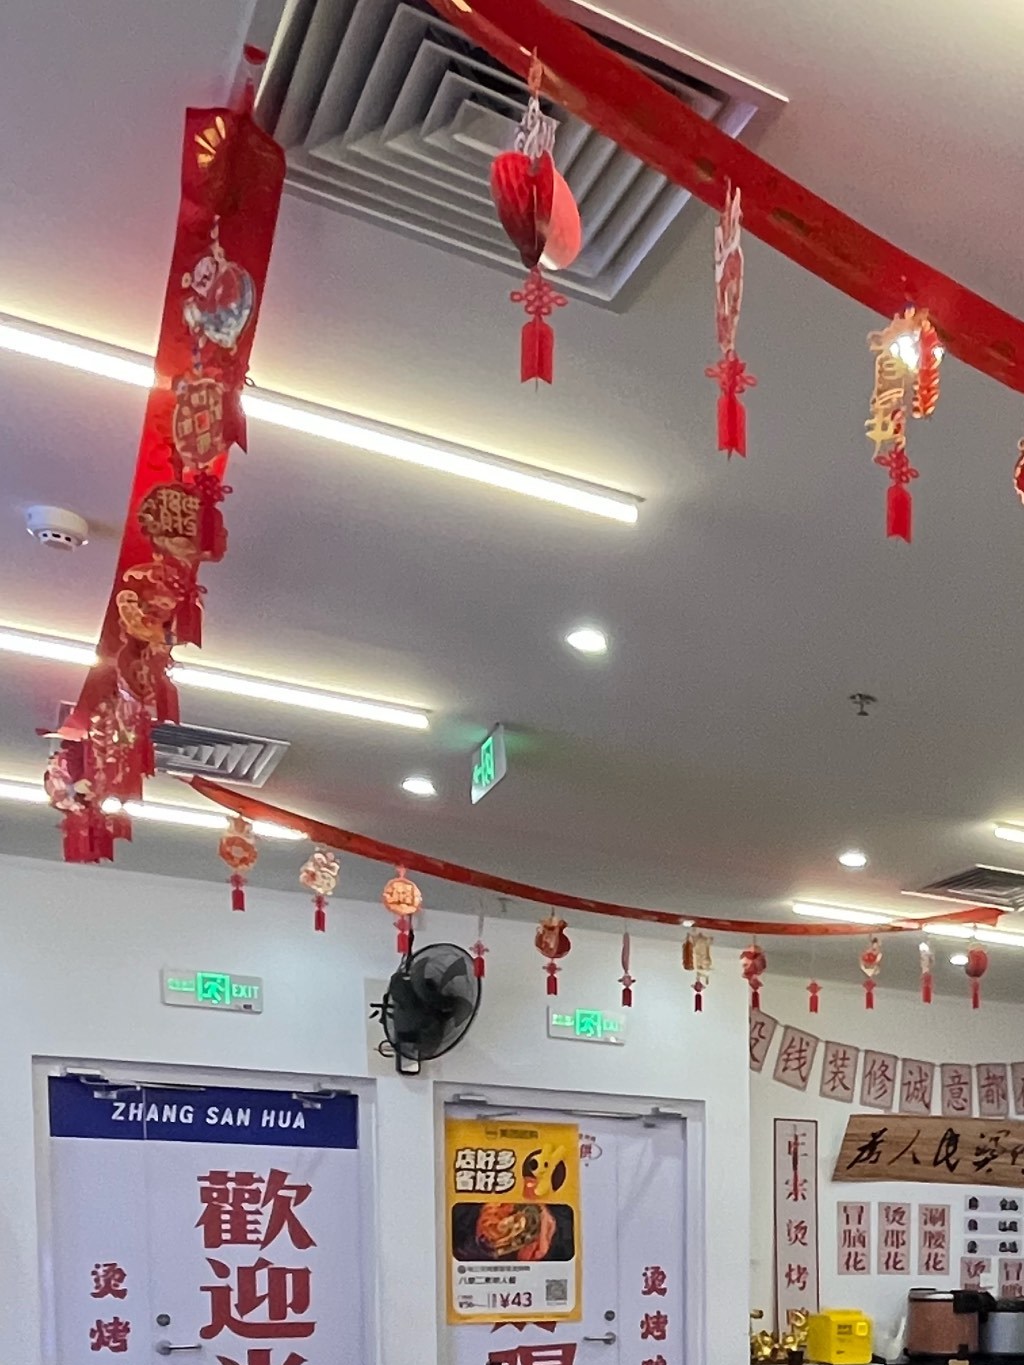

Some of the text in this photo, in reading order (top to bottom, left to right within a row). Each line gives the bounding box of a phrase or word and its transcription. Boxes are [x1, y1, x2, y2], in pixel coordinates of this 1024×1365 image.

[231, 984, 259, 999] EXIT
[111, 1102, 306, 1129] ZHANG SAN HUA
[455, 1149, 516, 1170] 店好多
[455, 1170, 516, 1192] 省好多
[500, 1291, 533, 1308] ¥43
